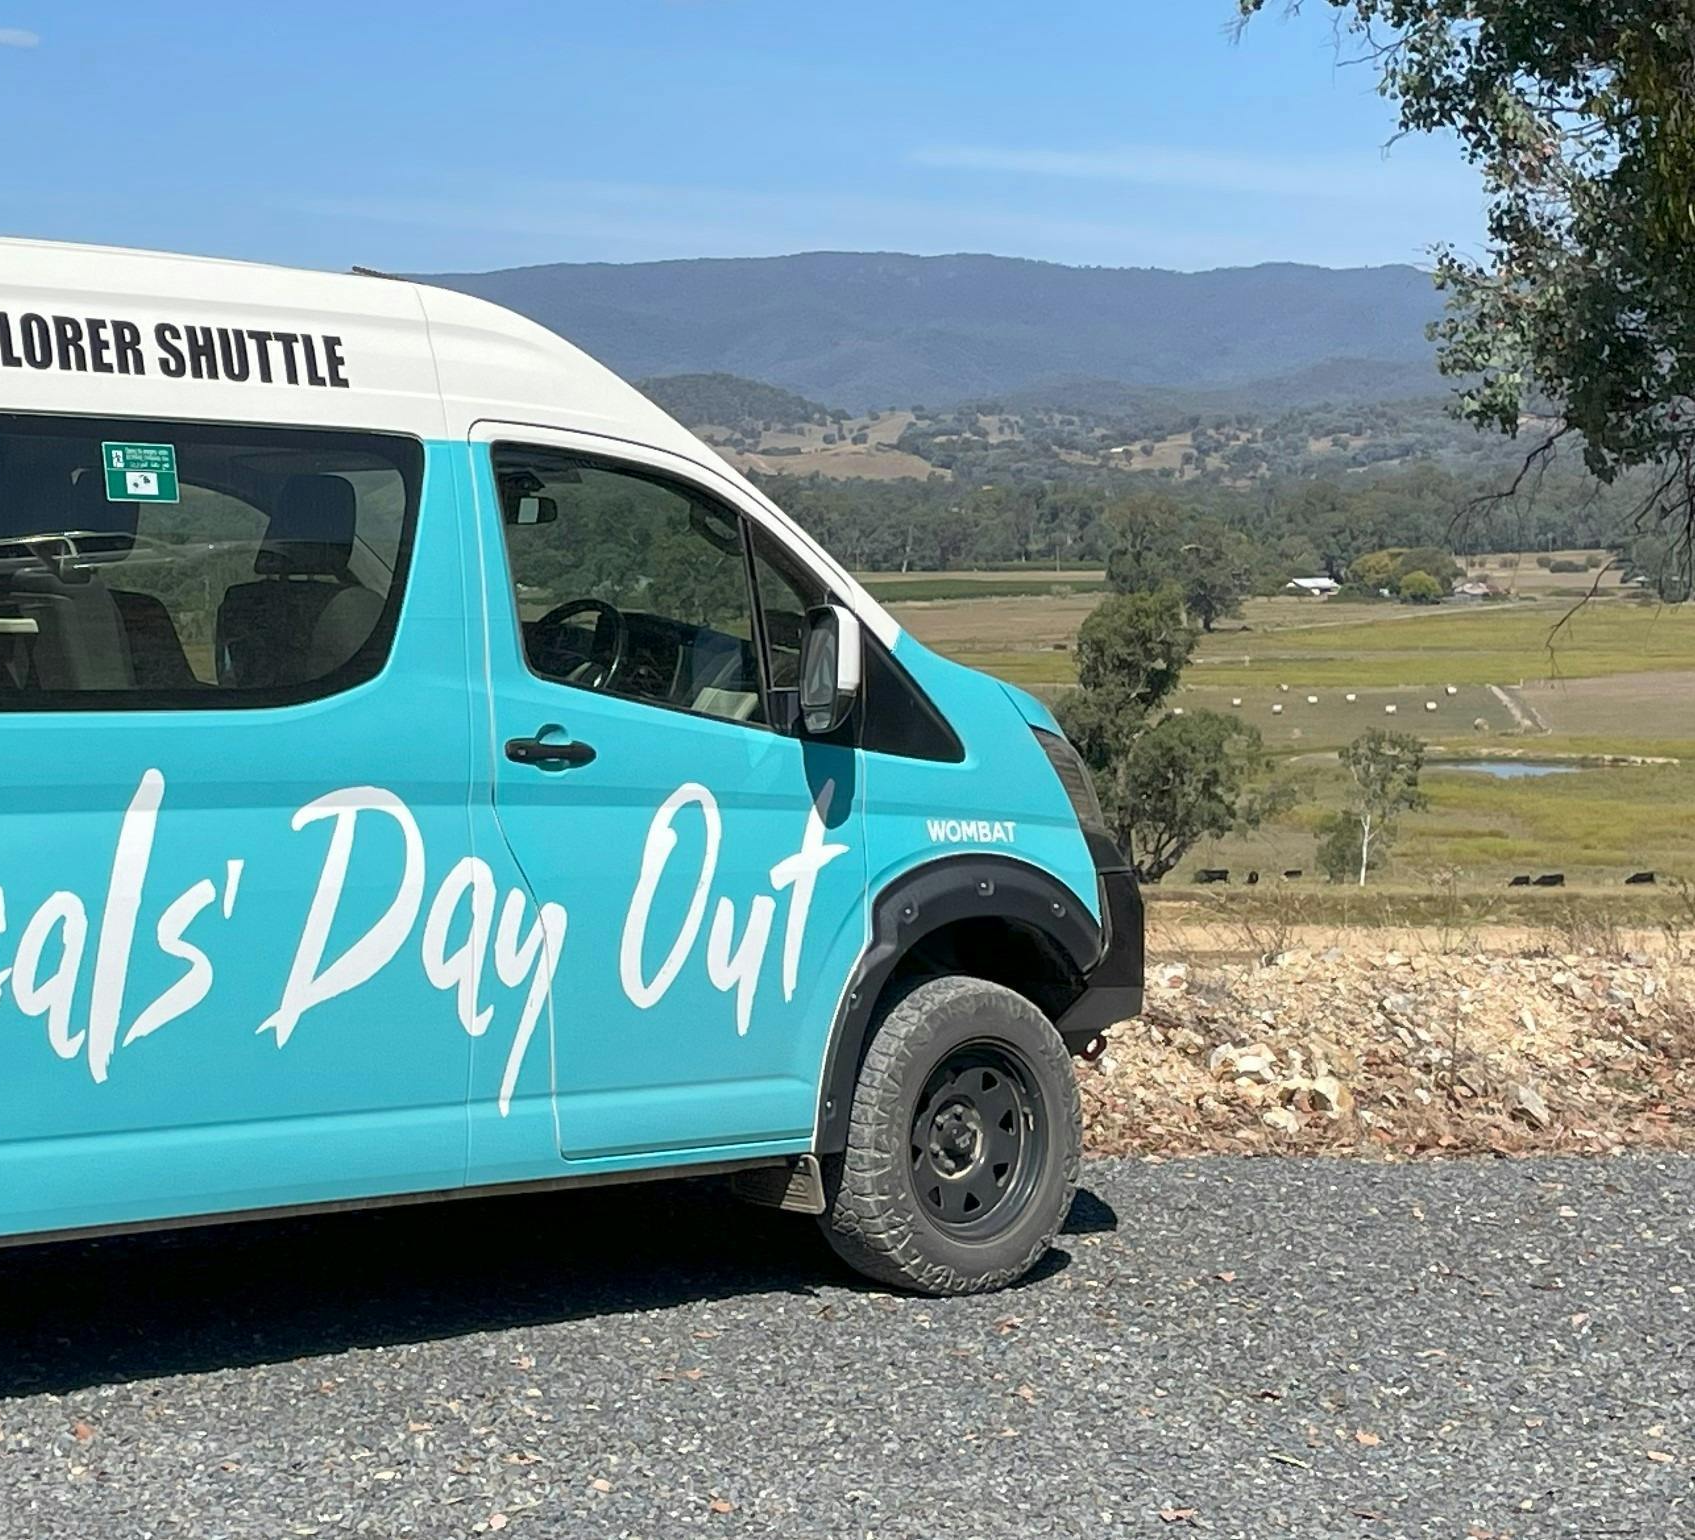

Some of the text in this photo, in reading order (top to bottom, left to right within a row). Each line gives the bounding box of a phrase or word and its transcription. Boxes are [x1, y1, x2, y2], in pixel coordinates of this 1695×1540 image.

[154, 323, 350, 389] SHUTTLE
[926, 819, 1017, 843] WOMBAT
[255, 785, 568, 1118] Day
[619, 778, 849, 1037] Out
